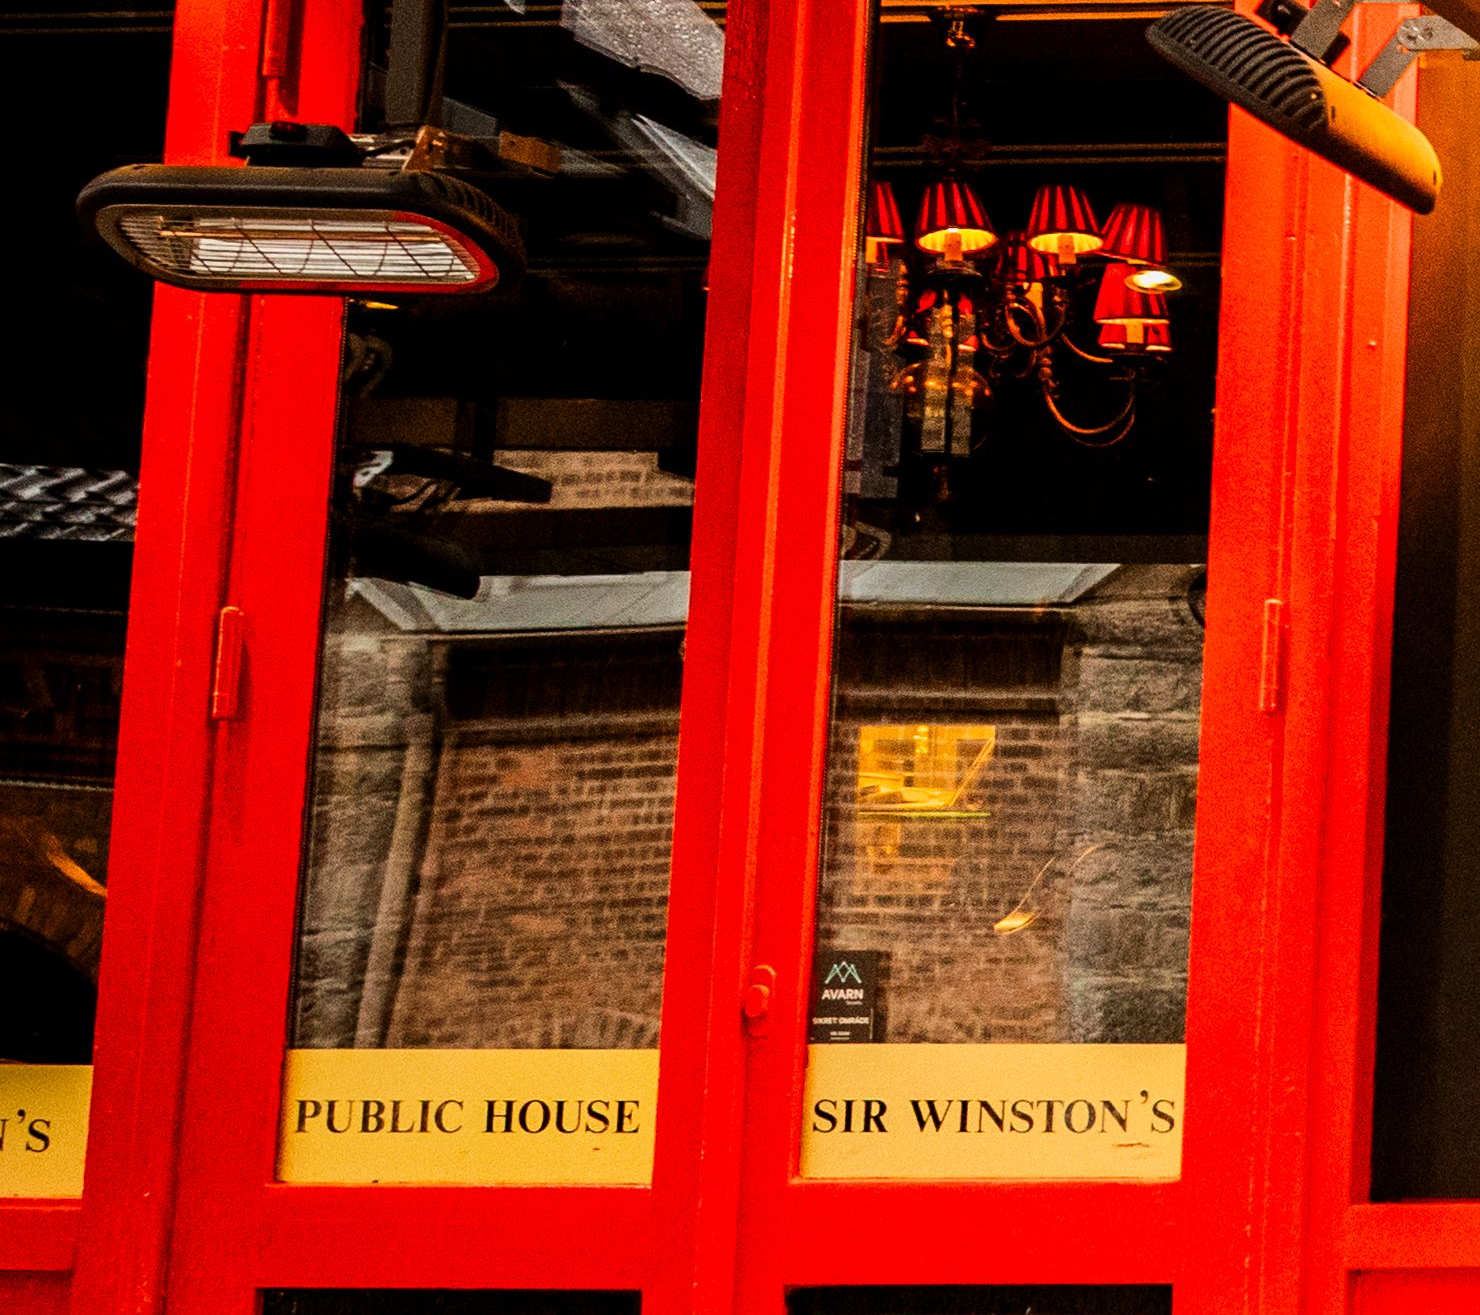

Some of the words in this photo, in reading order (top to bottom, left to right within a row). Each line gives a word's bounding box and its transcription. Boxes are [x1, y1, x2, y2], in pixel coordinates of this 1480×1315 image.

[821, 988, 864, 1000] AVARN
[295, 1099, 464, 1134] PUBLIC
[484, 1099, 640, 1134] HOUSE
[812, 1099, 888, 1134] SIR
[909, 1089, 1175, 1134] WINSTON'S
